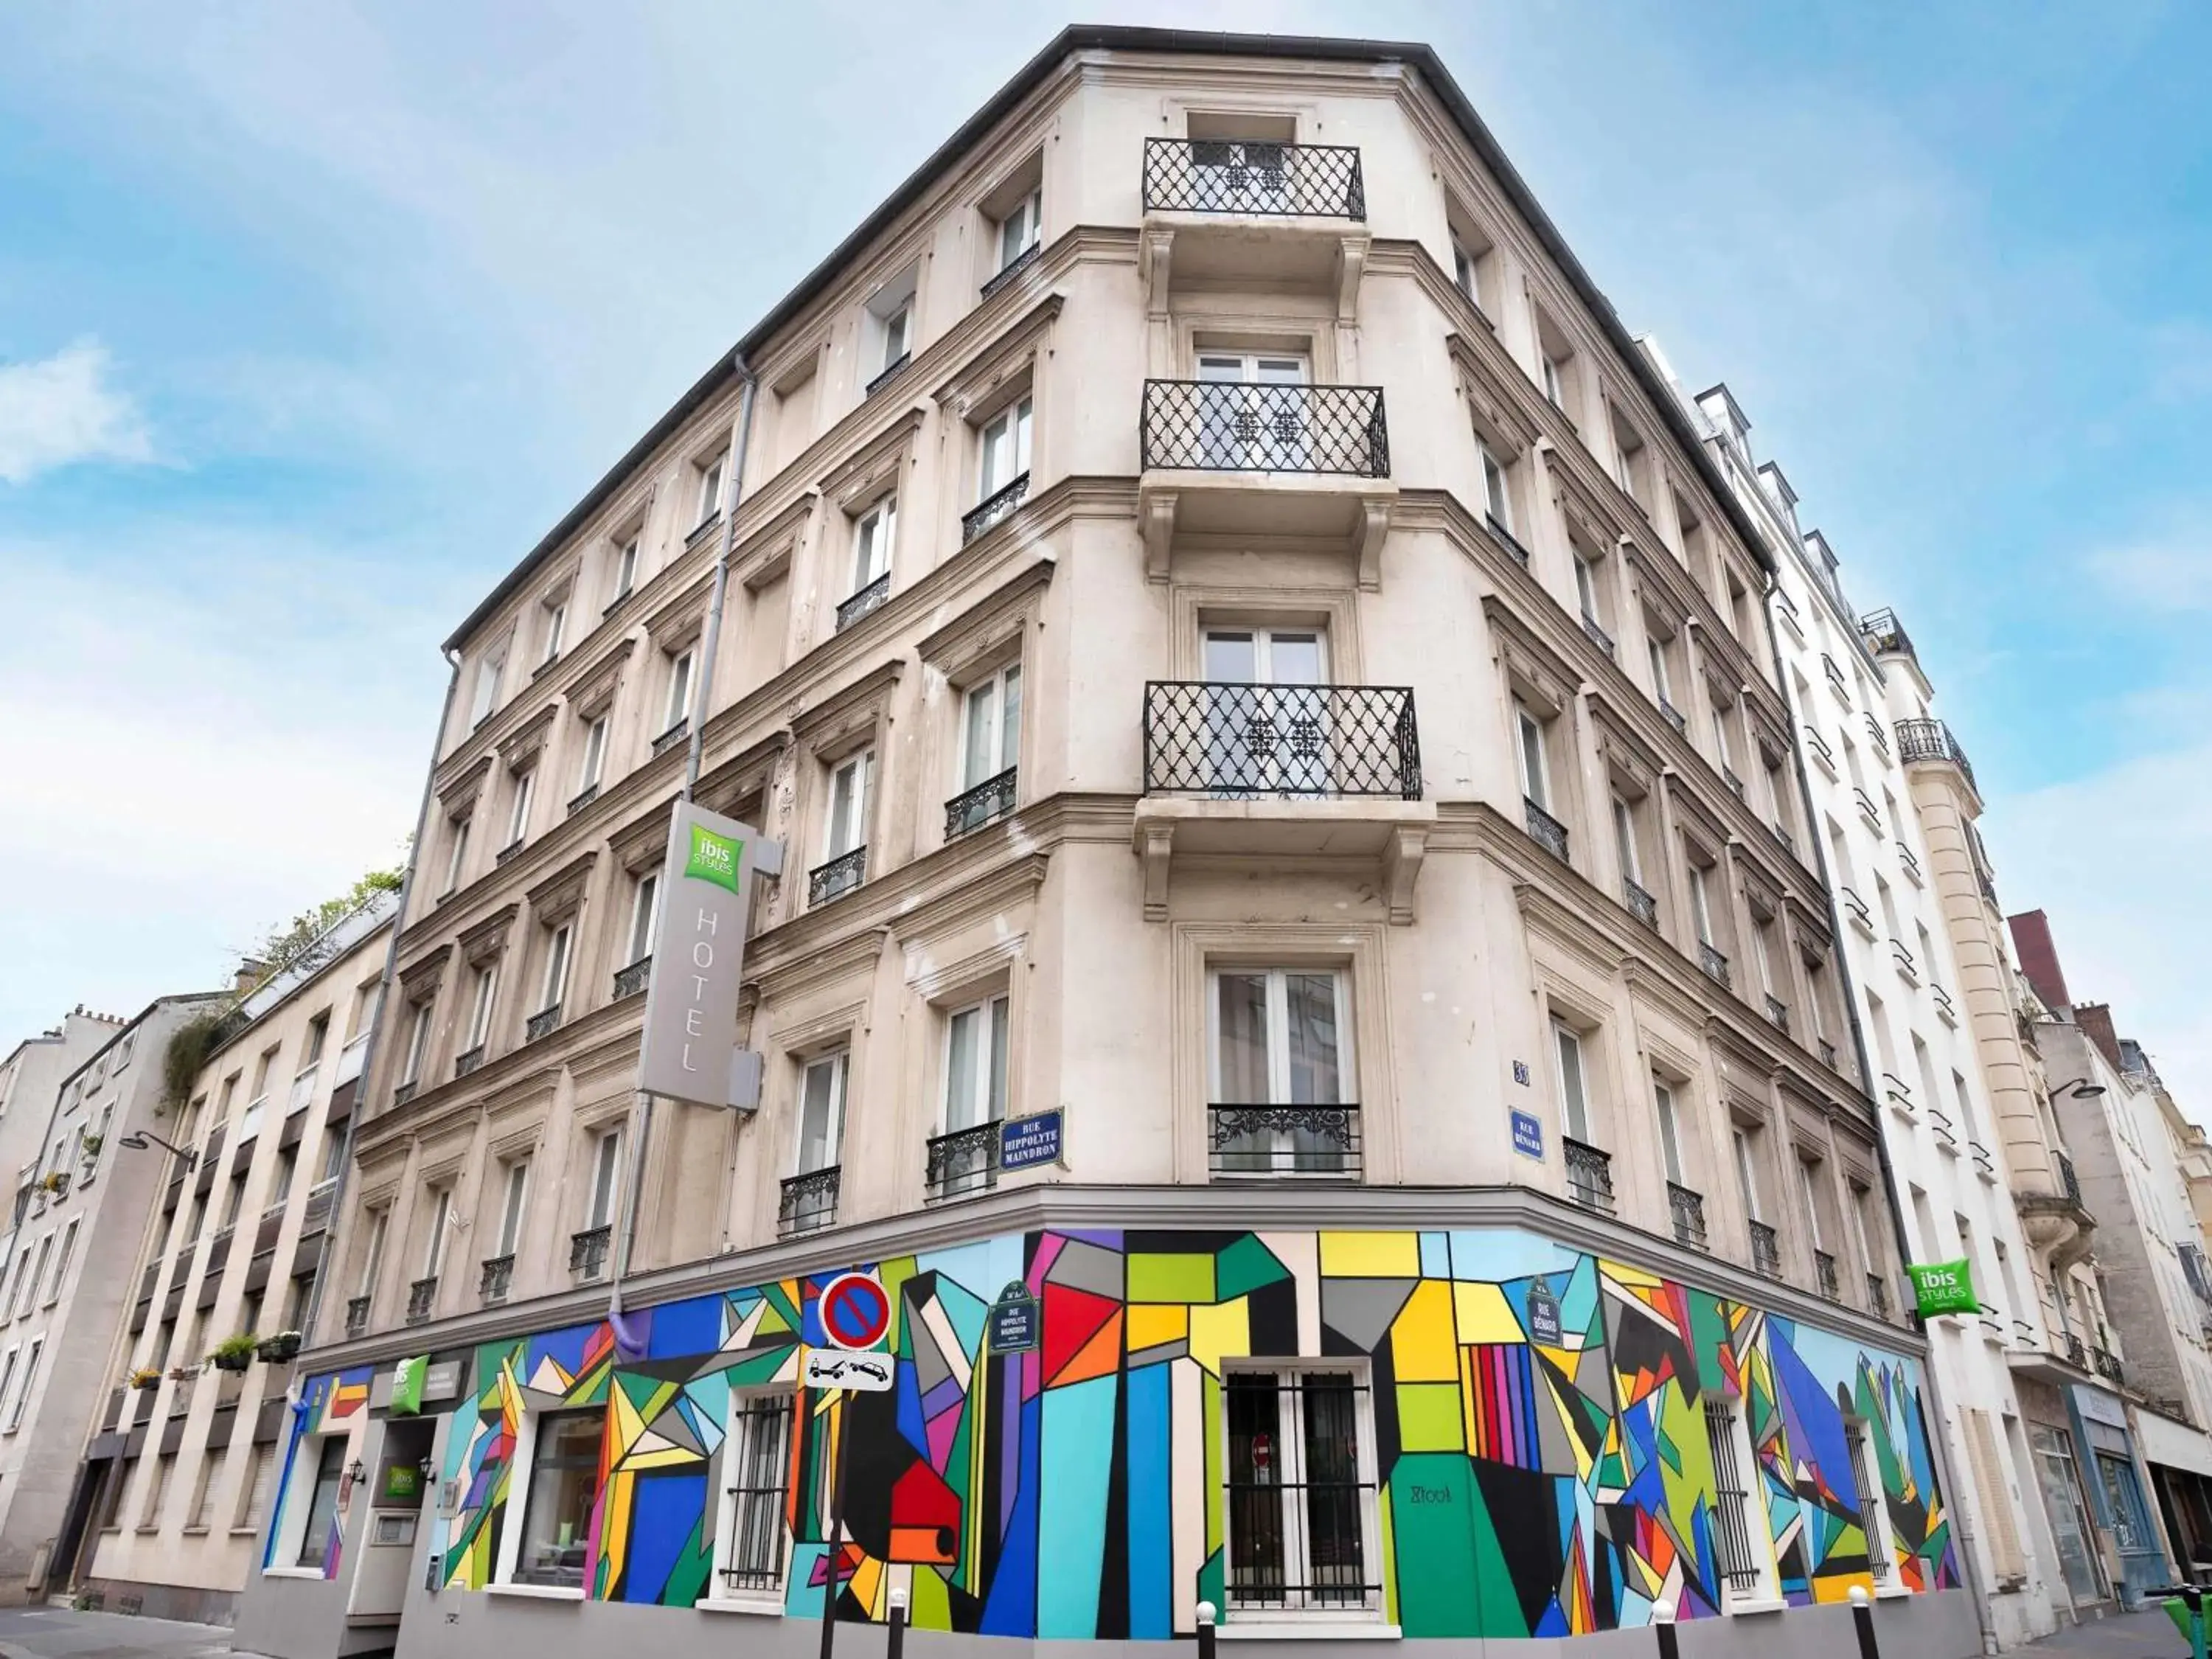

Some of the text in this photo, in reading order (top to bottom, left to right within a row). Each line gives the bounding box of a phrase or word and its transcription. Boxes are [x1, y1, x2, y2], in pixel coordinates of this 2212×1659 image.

[700, 837, 730, 862] ibis
[683, 907, 718, 1072] HOTEL
[1023, 1121, 1041, 1135] RUE
[1005, 1129, 1058, 1151] HIPPOLYTE
[1005, 1142, 1057, 1164] MAINDRON
[1919, 1269, 1958, 1289] ibis
